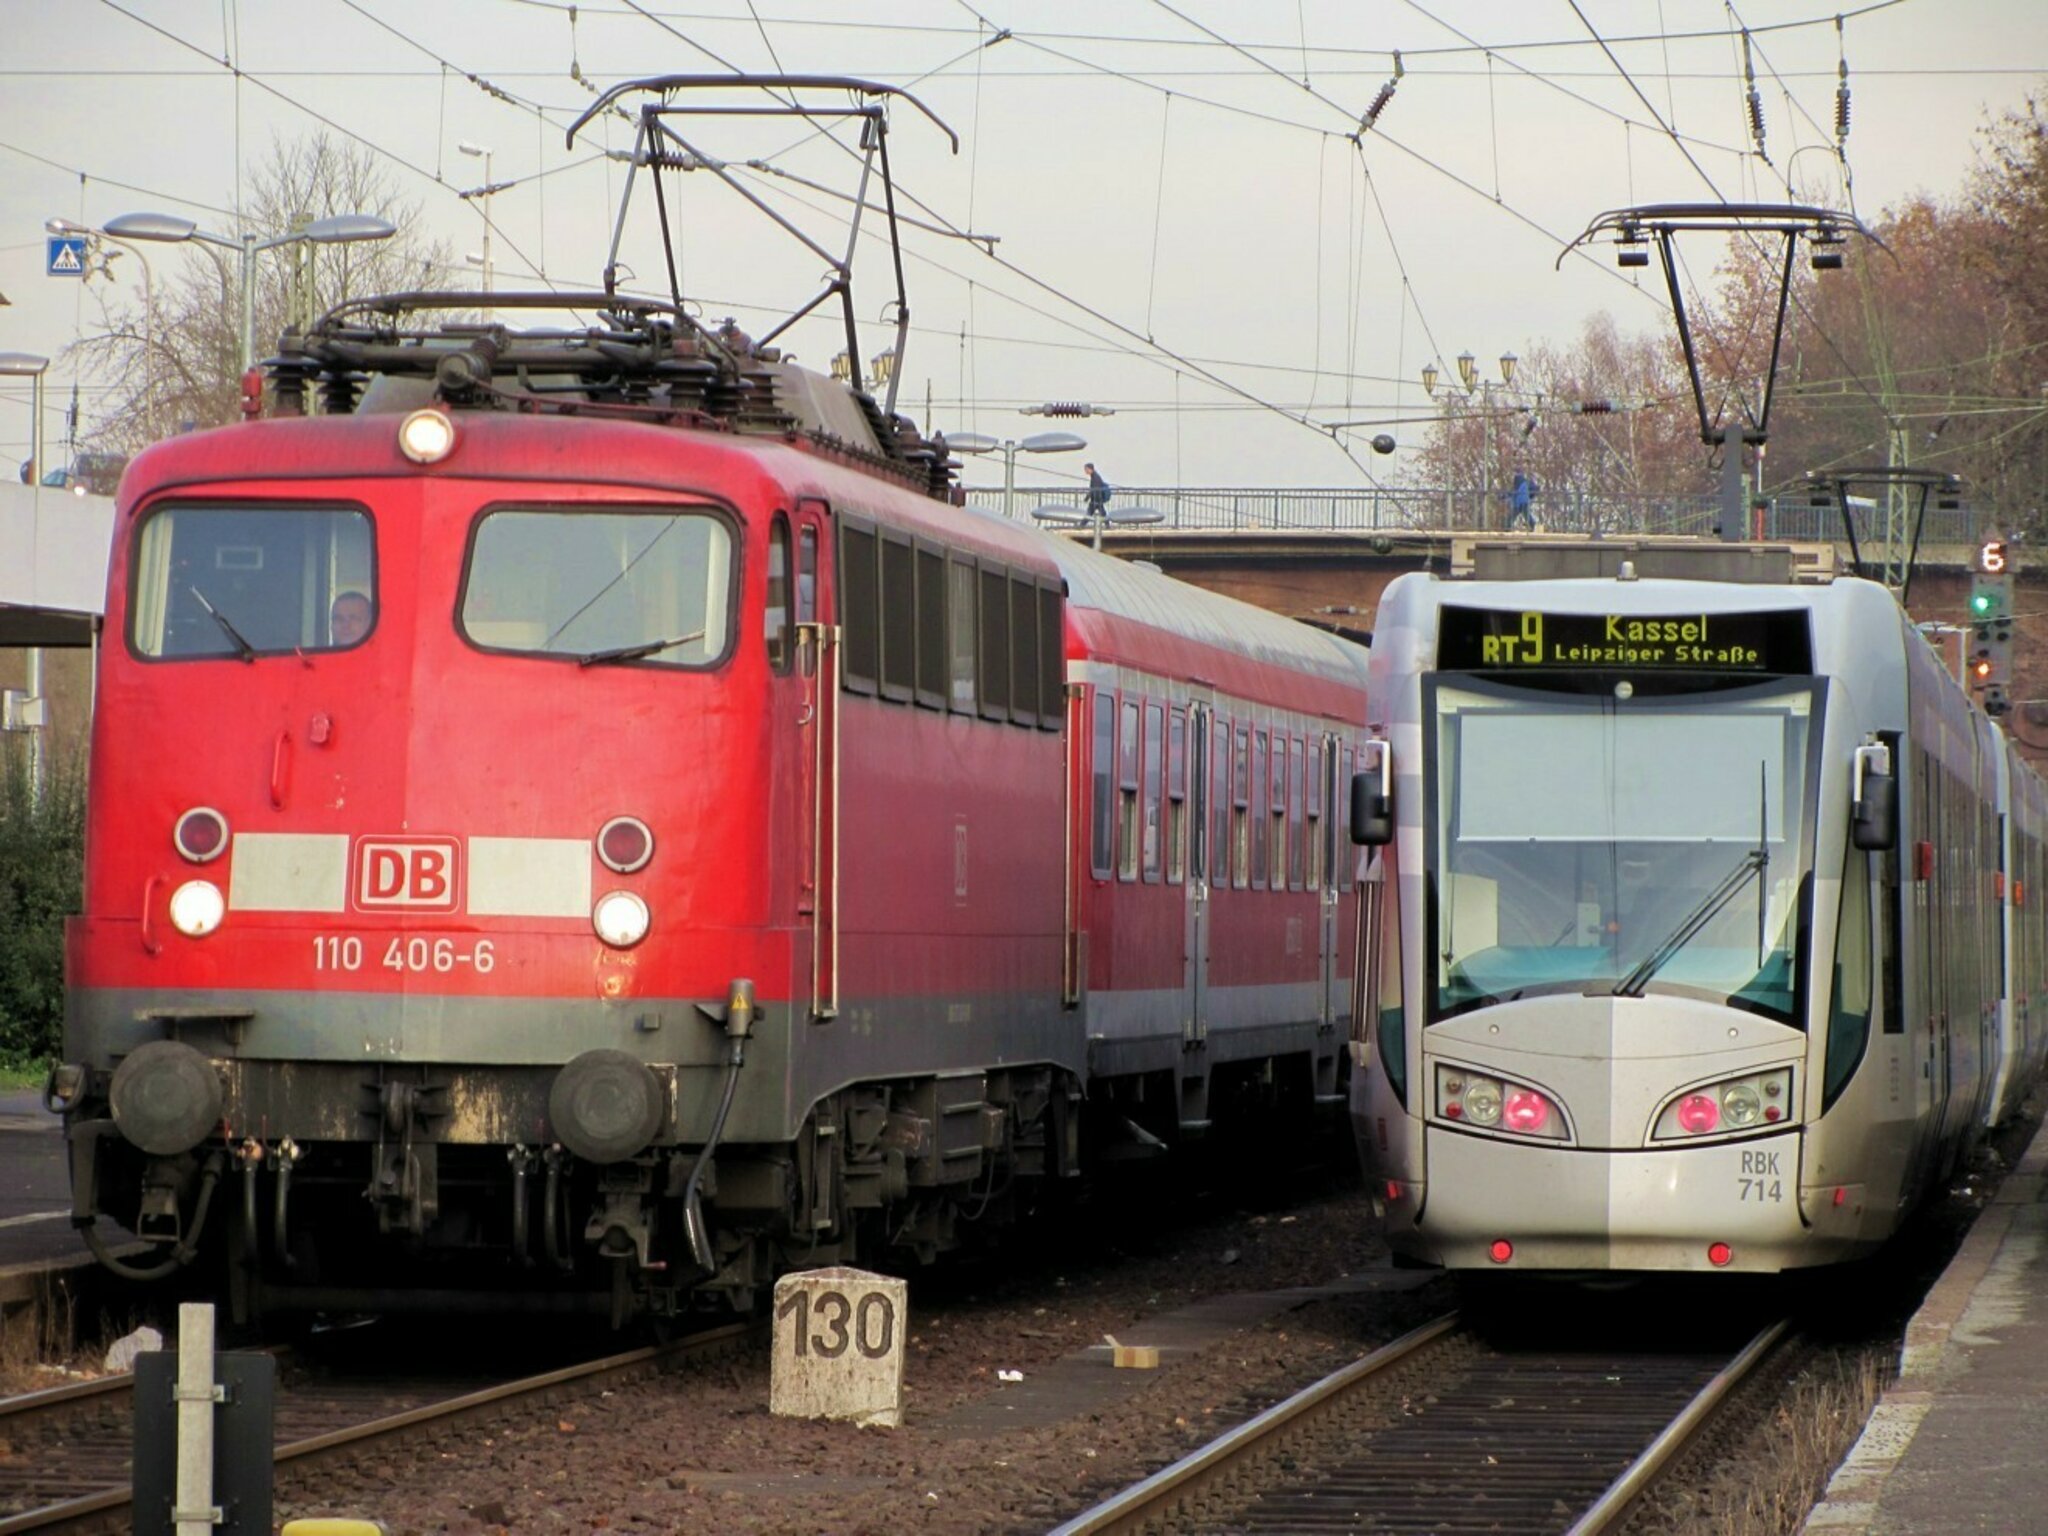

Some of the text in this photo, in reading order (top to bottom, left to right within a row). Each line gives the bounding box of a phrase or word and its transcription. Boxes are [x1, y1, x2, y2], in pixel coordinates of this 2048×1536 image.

[1982, 542, 2004, 571] 6
[1482, 611, 1543, 663] RT9
[1606, 614, 1707, 642] Kassel
[1555, 644, 1758, 663] Leipziger Straße
[367, 848, 447, 899] DB
[313, 936, 495, 973] 110 406-6
[1742, 1150, 1780, 1175] RBK
[1738, 1178, 1782, 1202] 714
[778, 1289, 894, 1359] 130
